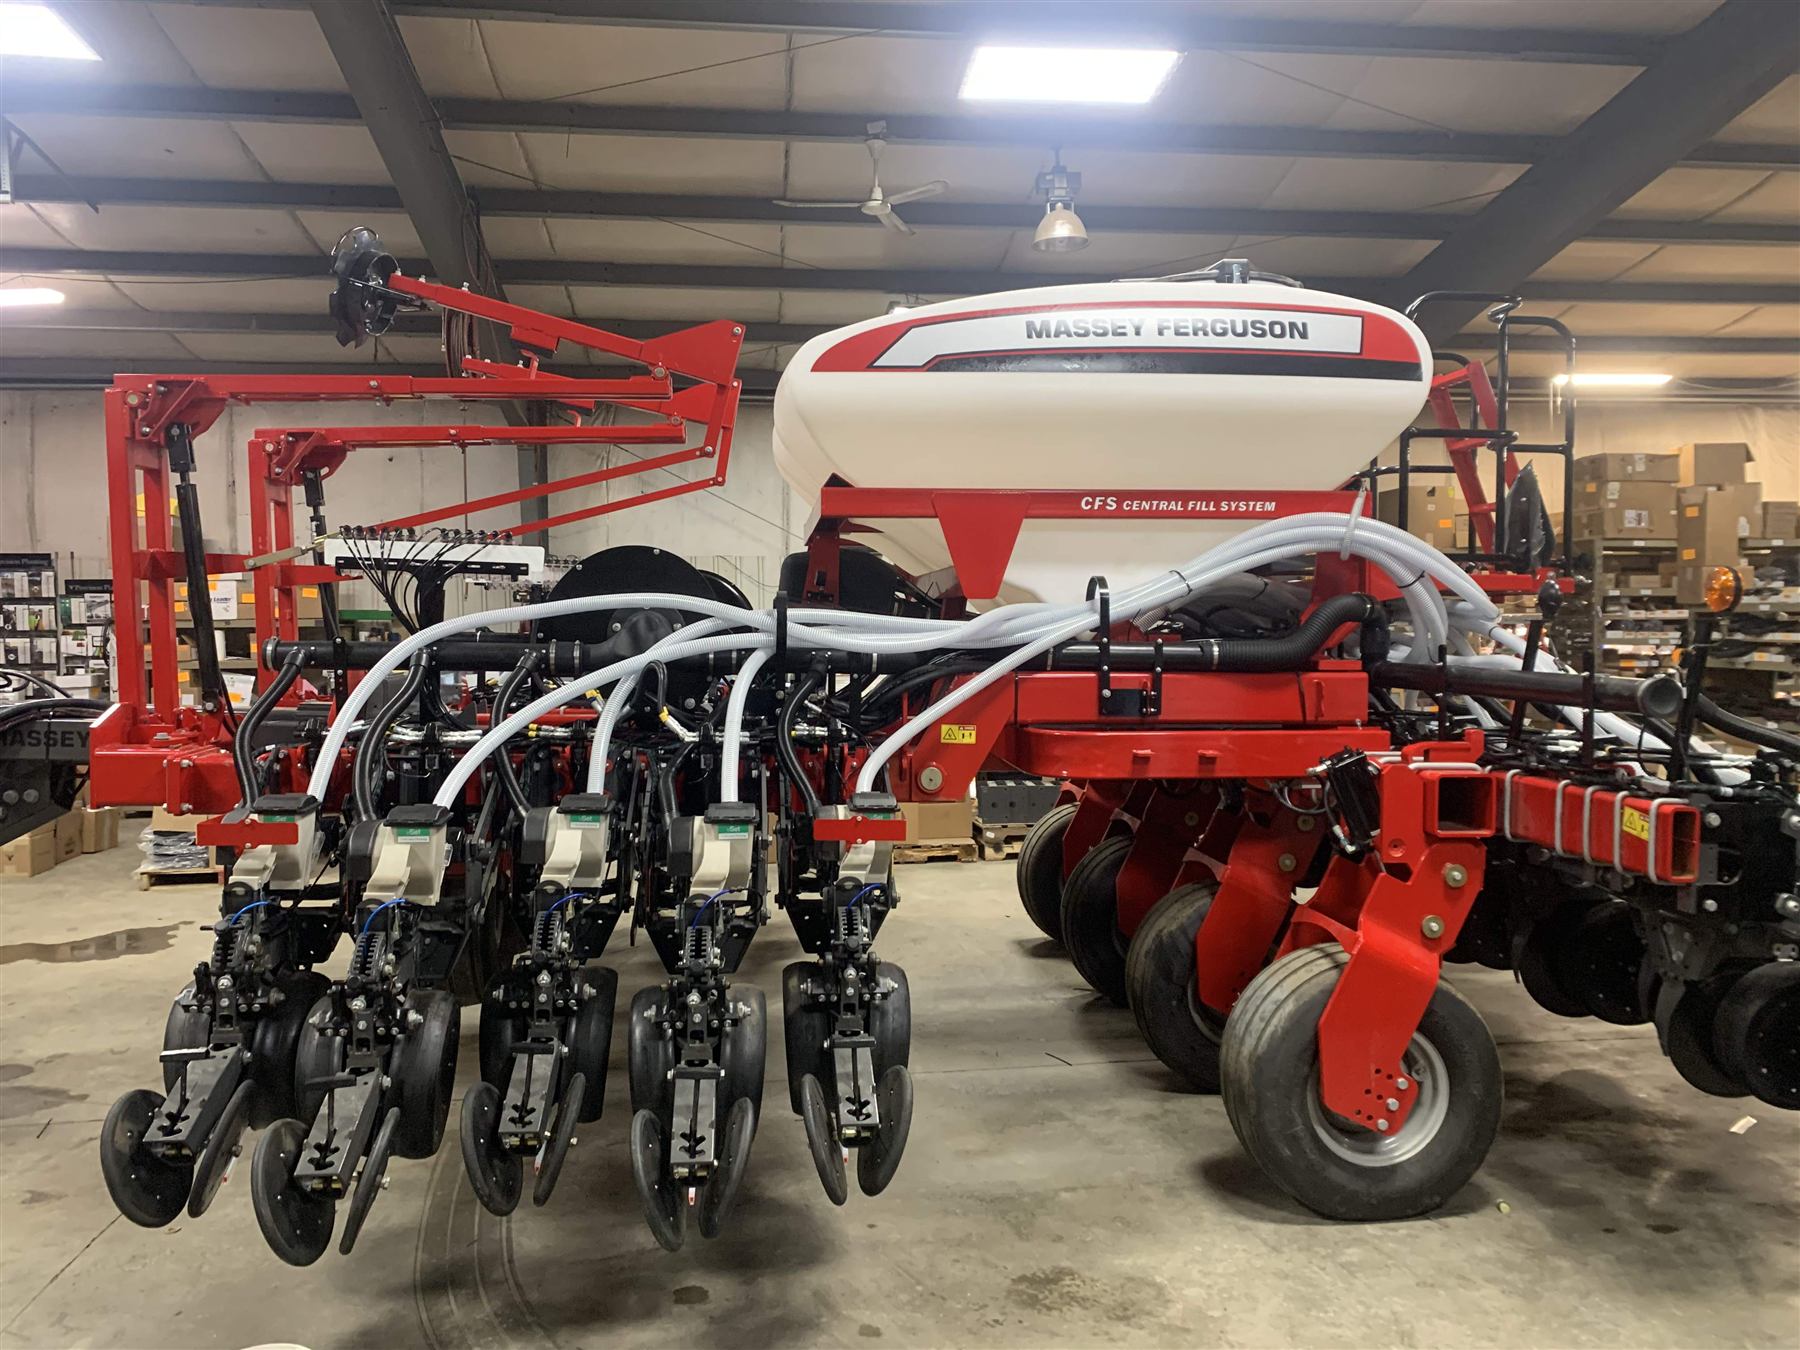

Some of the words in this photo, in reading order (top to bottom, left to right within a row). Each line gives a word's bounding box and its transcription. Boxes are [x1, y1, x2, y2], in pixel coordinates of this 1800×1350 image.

[1025, 319, 1147, 339] MASSEY
[1157, 318, 1309, 340] FERGUSON
[1080, 496, 1118, 511] CFS
[1123, 500, 1184, 511] CENTRAL
[1187, 500, 1217, 511] FILL
[1220, 501, 1276, 512] SYSTEM
